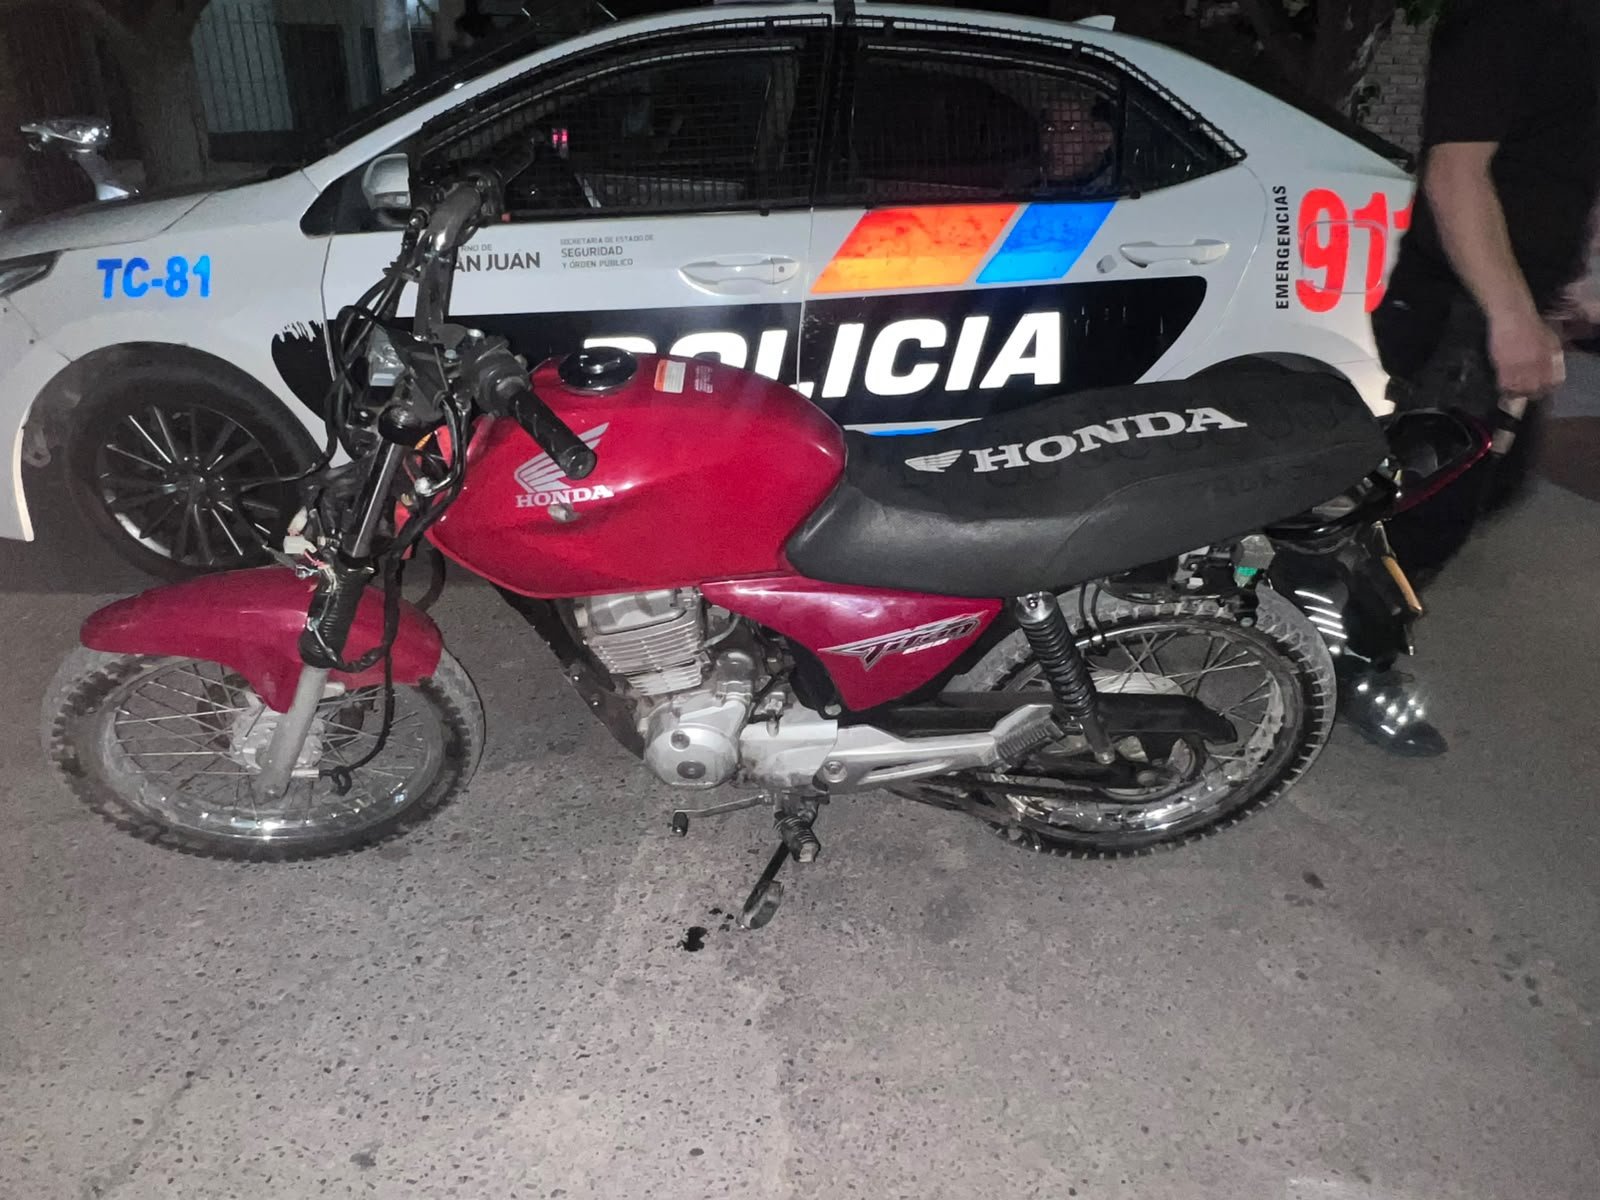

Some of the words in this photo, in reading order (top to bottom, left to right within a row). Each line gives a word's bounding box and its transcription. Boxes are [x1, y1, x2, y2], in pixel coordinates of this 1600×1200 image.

[561, 245, 624, 258] SEGURIDAD
[604, 236, 614, 244] DE
[616, 234, 644, 243] ESTADO
[645, 234, 654, 242] DE
[1272, 185, 1291, 310] EMERGENCIAS
[1295, 187, 1416, 313] 91
[96, 255, 211, 299] TC-81
[454, 254, 481, 272] AN
[584, 311, 1061, 399] LICIA
[969, 407, 1248, 473] HONDA
[515, 484, 615, 508] HONDA
